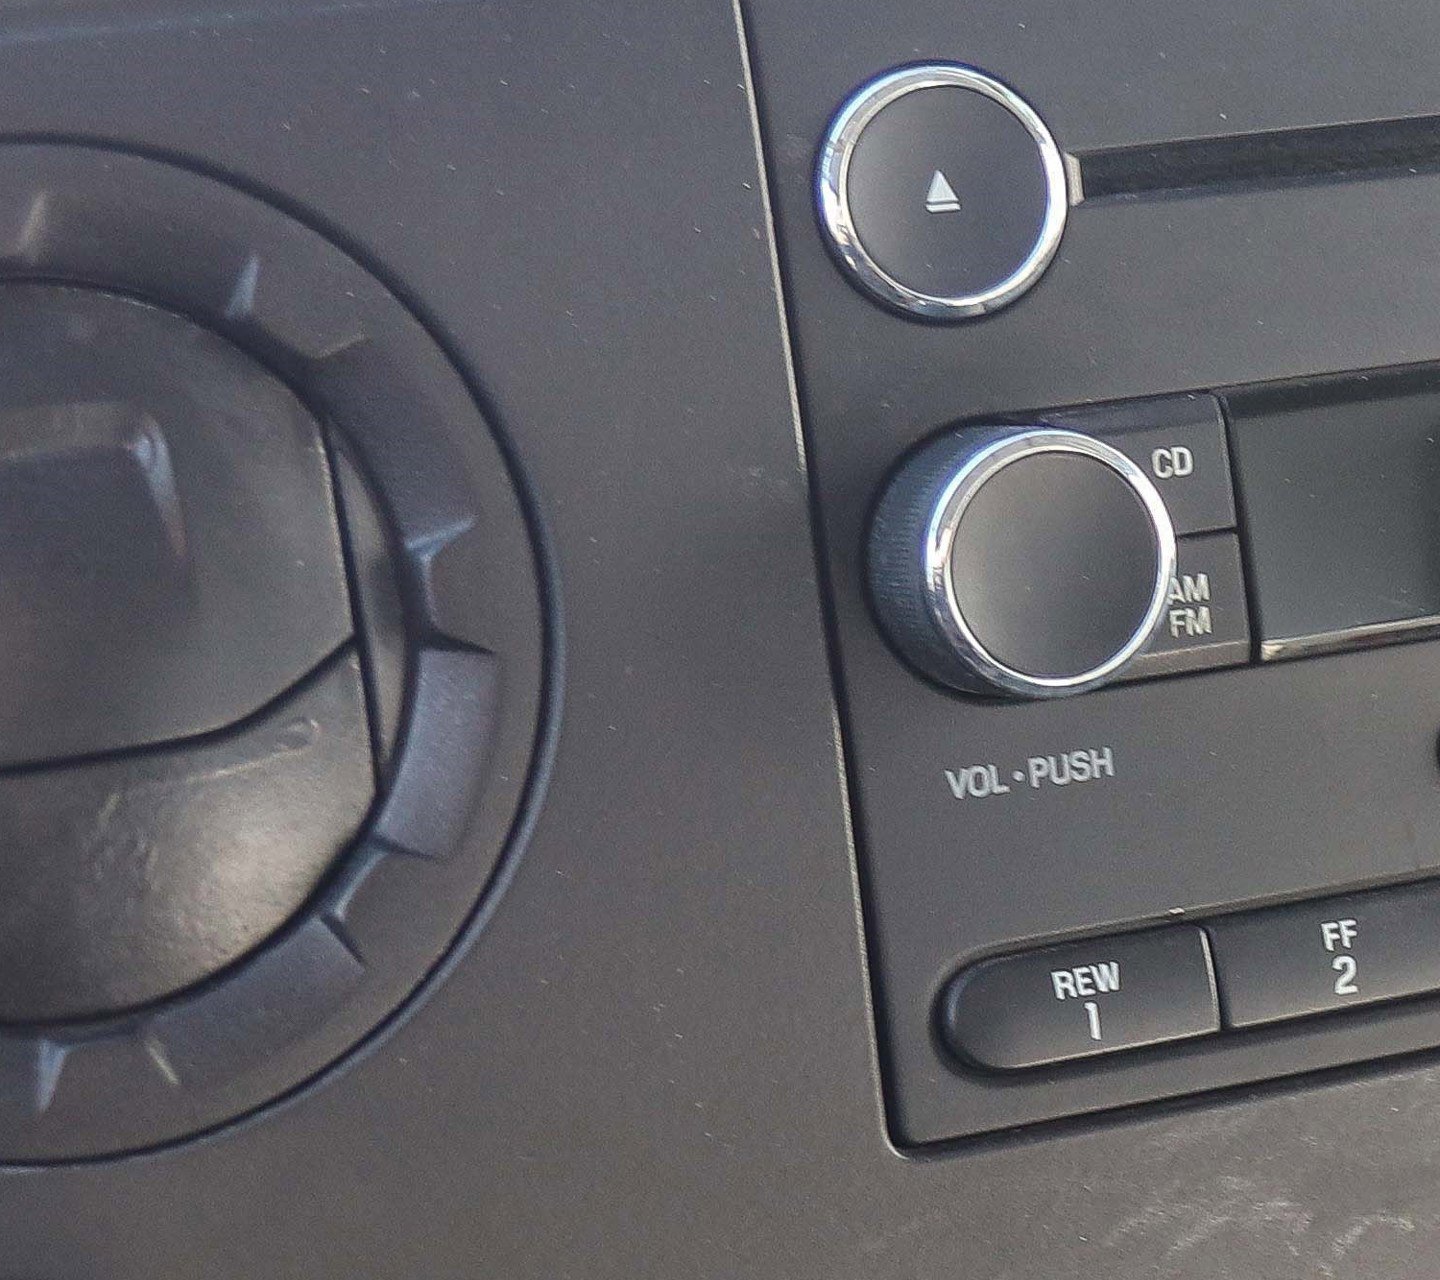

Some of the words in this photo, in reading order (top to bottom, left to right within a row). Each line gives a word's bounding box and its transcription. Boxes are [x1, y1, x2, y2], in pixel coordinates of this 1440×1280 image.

[1153, 447, 1192, 477] CD
[1167, 573, 1209, 604] AM
[1170, 607, 1211, 636] FM
[1322, 920, 1356, 950] FF
[1052, 962, 1118, 999] REW
[1334, 957, 1357, 994] 2
[1085, 1002, 1100, 1039] 1
